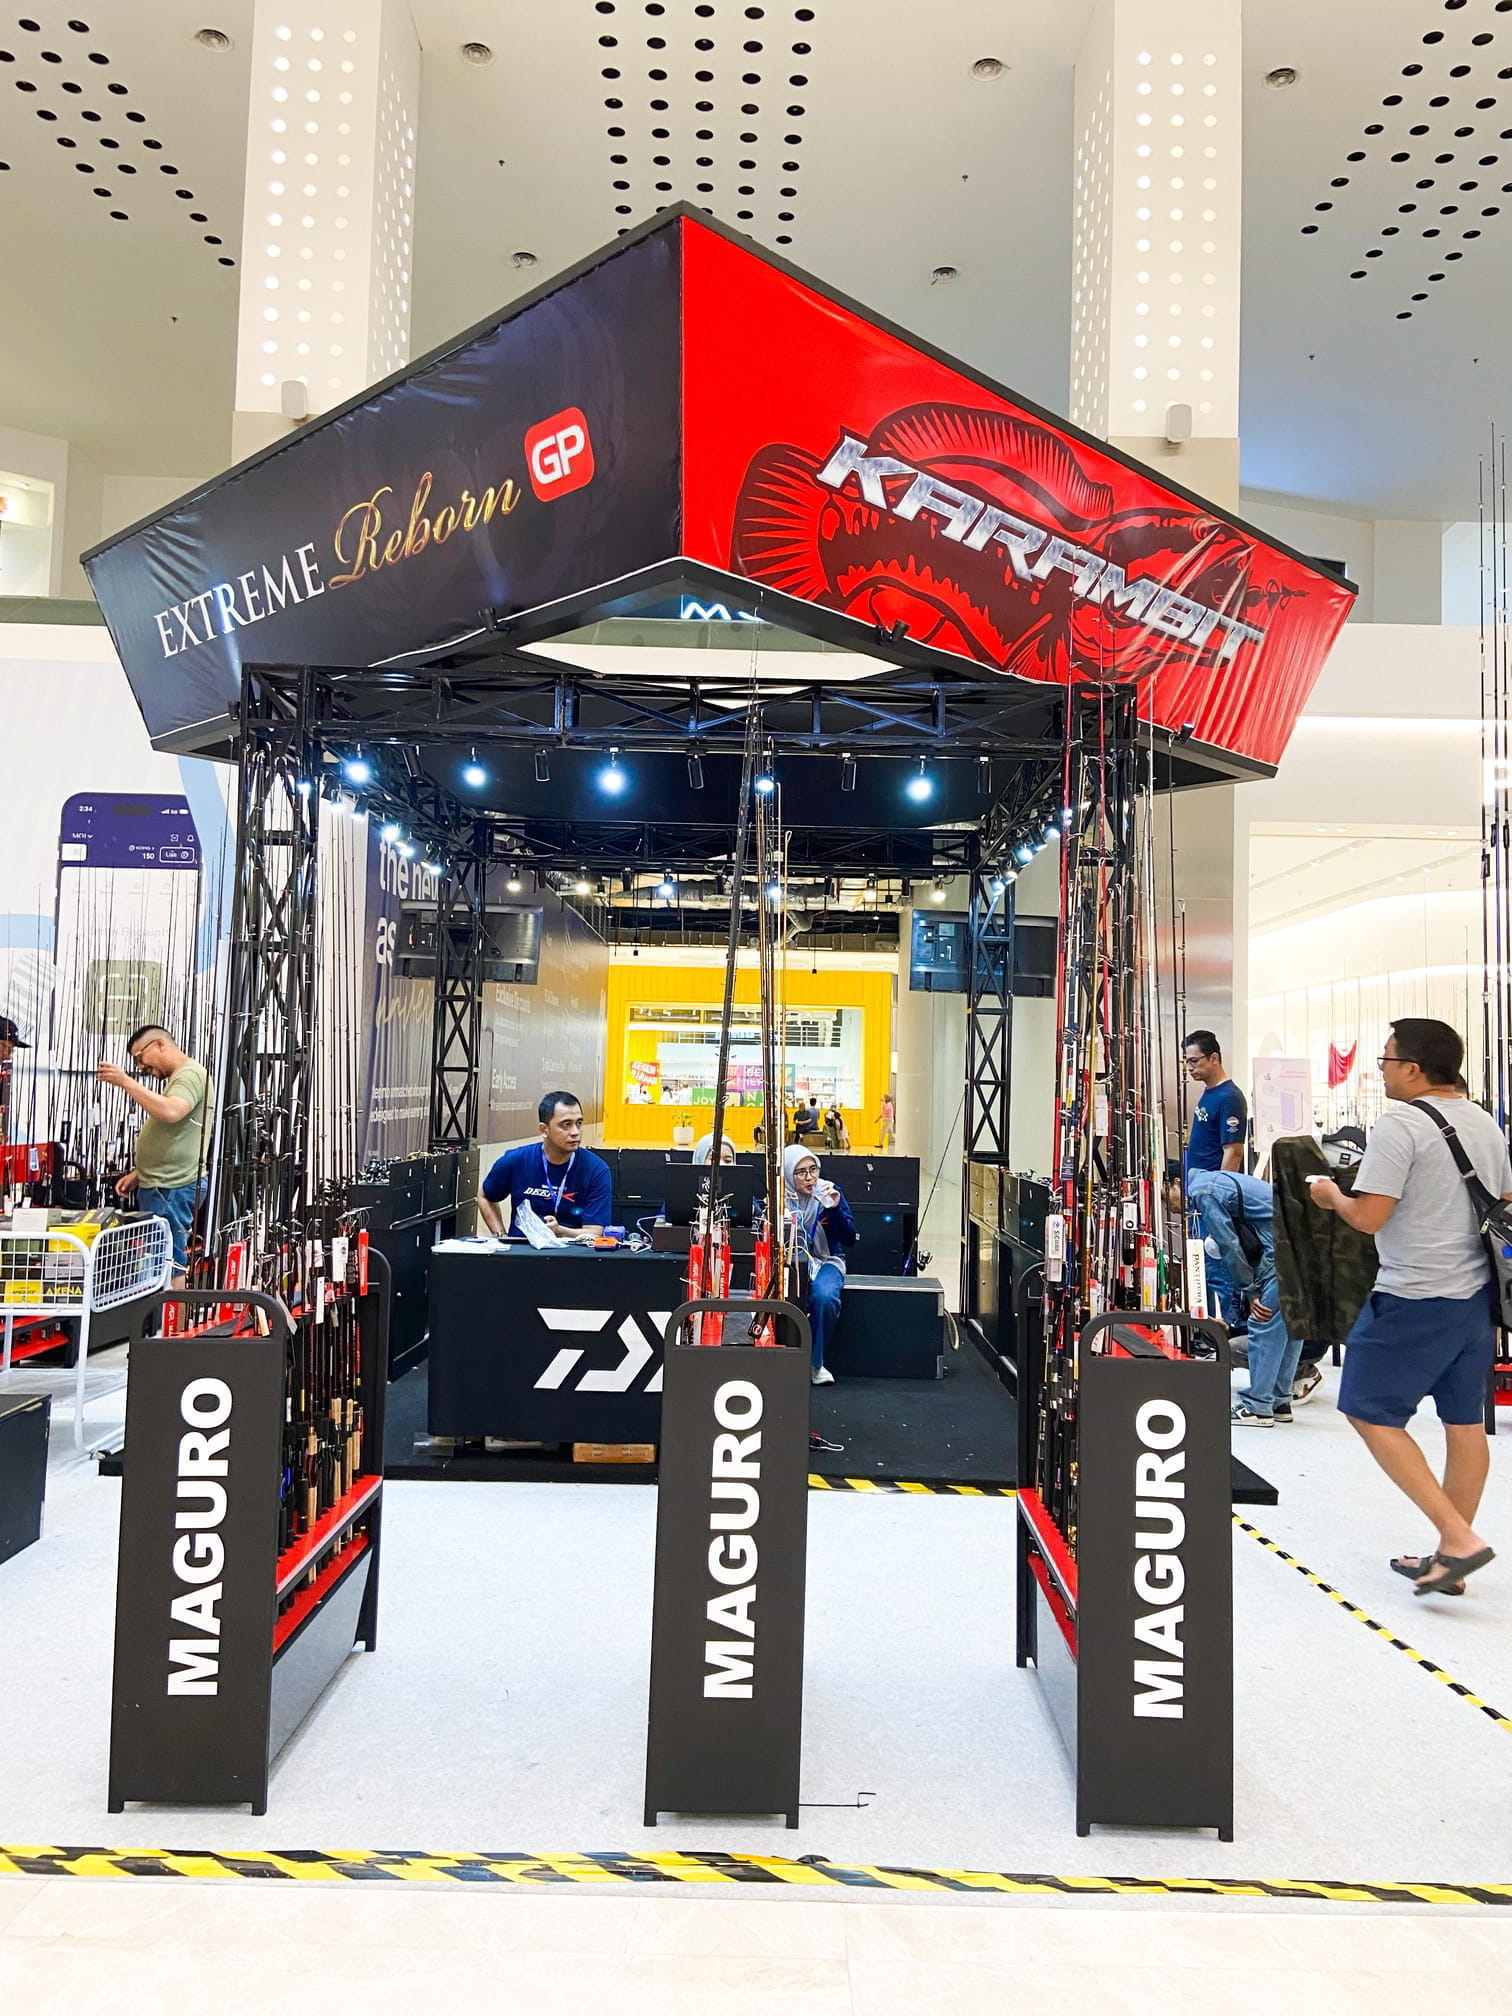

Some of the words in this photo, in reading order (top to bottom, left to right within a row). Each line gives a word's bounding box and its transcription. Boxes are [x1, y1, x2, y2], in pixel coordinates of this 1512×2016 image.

[153, 543, 326, 659] EXTREME
[328, 472, 522, 590] Reborn
[531, 424, 586, 485] GP
[816, 435, 1266, 661] KARAMBIT
[380, 840, 409, 900] the
[168, 1377, 233, 1696] MAGURO
[703, 1379, 764, 1700] MAGURO
[1133, 1398, 1188, 1720] MAGURO
